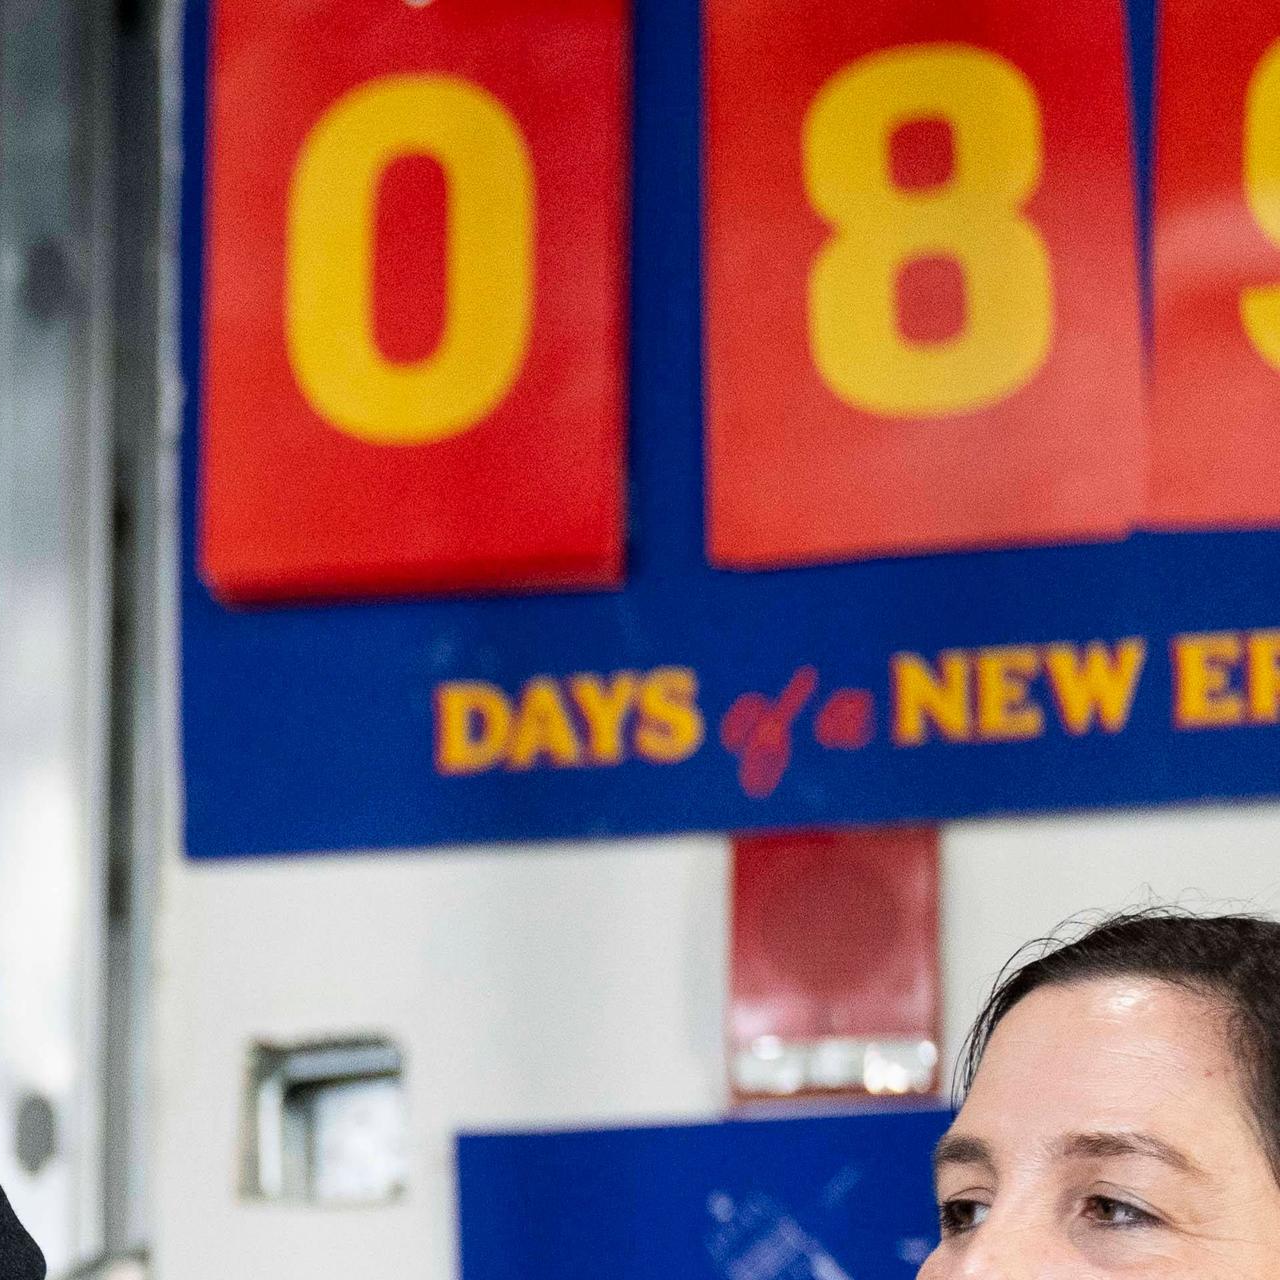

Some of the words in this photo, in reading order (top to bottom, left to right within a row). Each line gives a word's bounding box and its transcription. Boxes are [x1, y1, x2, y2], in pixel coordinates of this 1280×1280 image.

[800, 42, 1056, 420] 8
[435, 667, 704, 776] DAYS
[890, 637, 1146, 746] NEW
